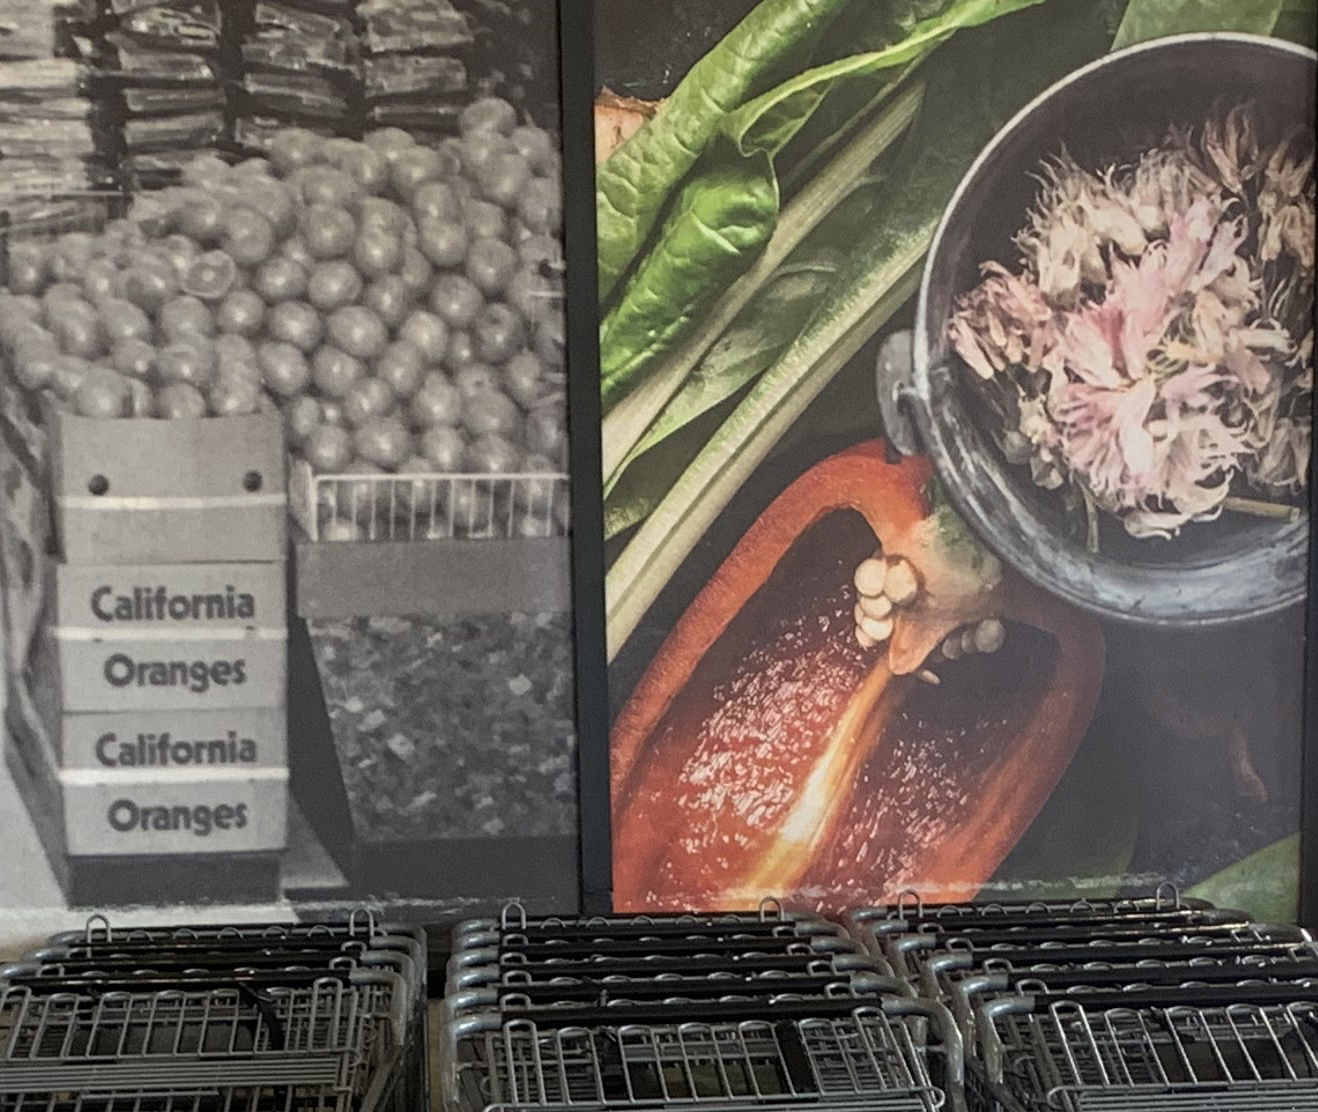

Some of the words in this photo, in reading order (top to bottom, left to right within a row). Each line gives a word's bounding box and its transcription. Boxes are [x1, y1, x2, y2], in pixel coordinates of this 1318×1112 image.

[90, 584, 256, 622] California
[103, 653, 248, 694] Oranges
[95, 730, 258, 767] California
[107, 799, 248, 837] Oranges
